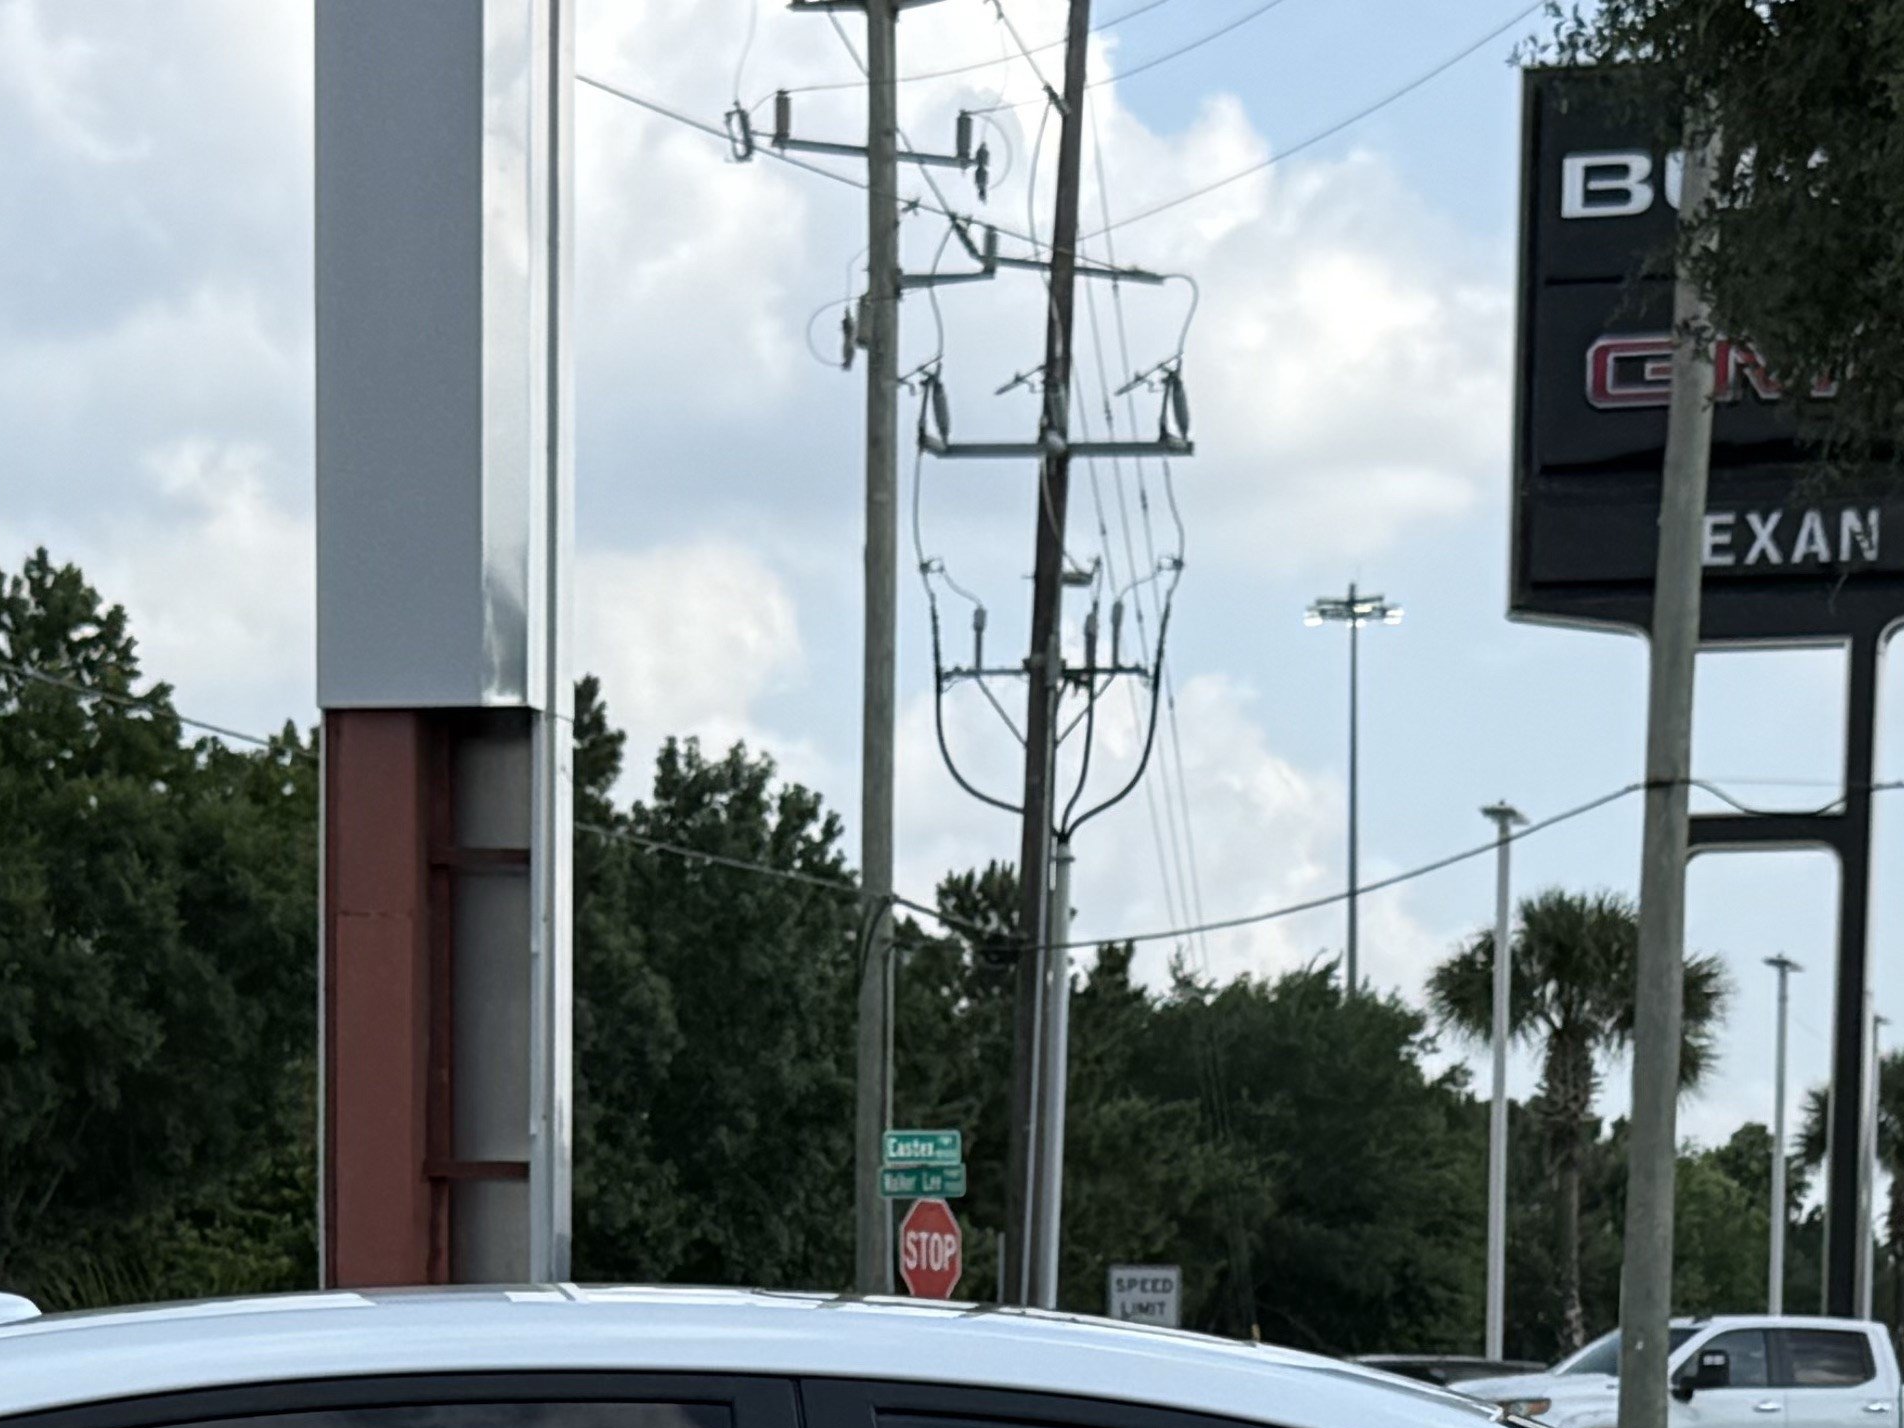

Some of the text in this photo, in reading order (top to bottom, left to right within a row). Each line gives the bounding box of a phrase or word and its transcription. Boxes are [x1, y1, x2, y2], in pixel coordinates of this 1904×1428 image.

[1700, 507, 1880, 567] EXAN
[905, 1230, 957, 1271] STOP
[1116, 1277, 1174, 1294] SPEED
[1120, 1301, 1166, 1317] LIMIT
